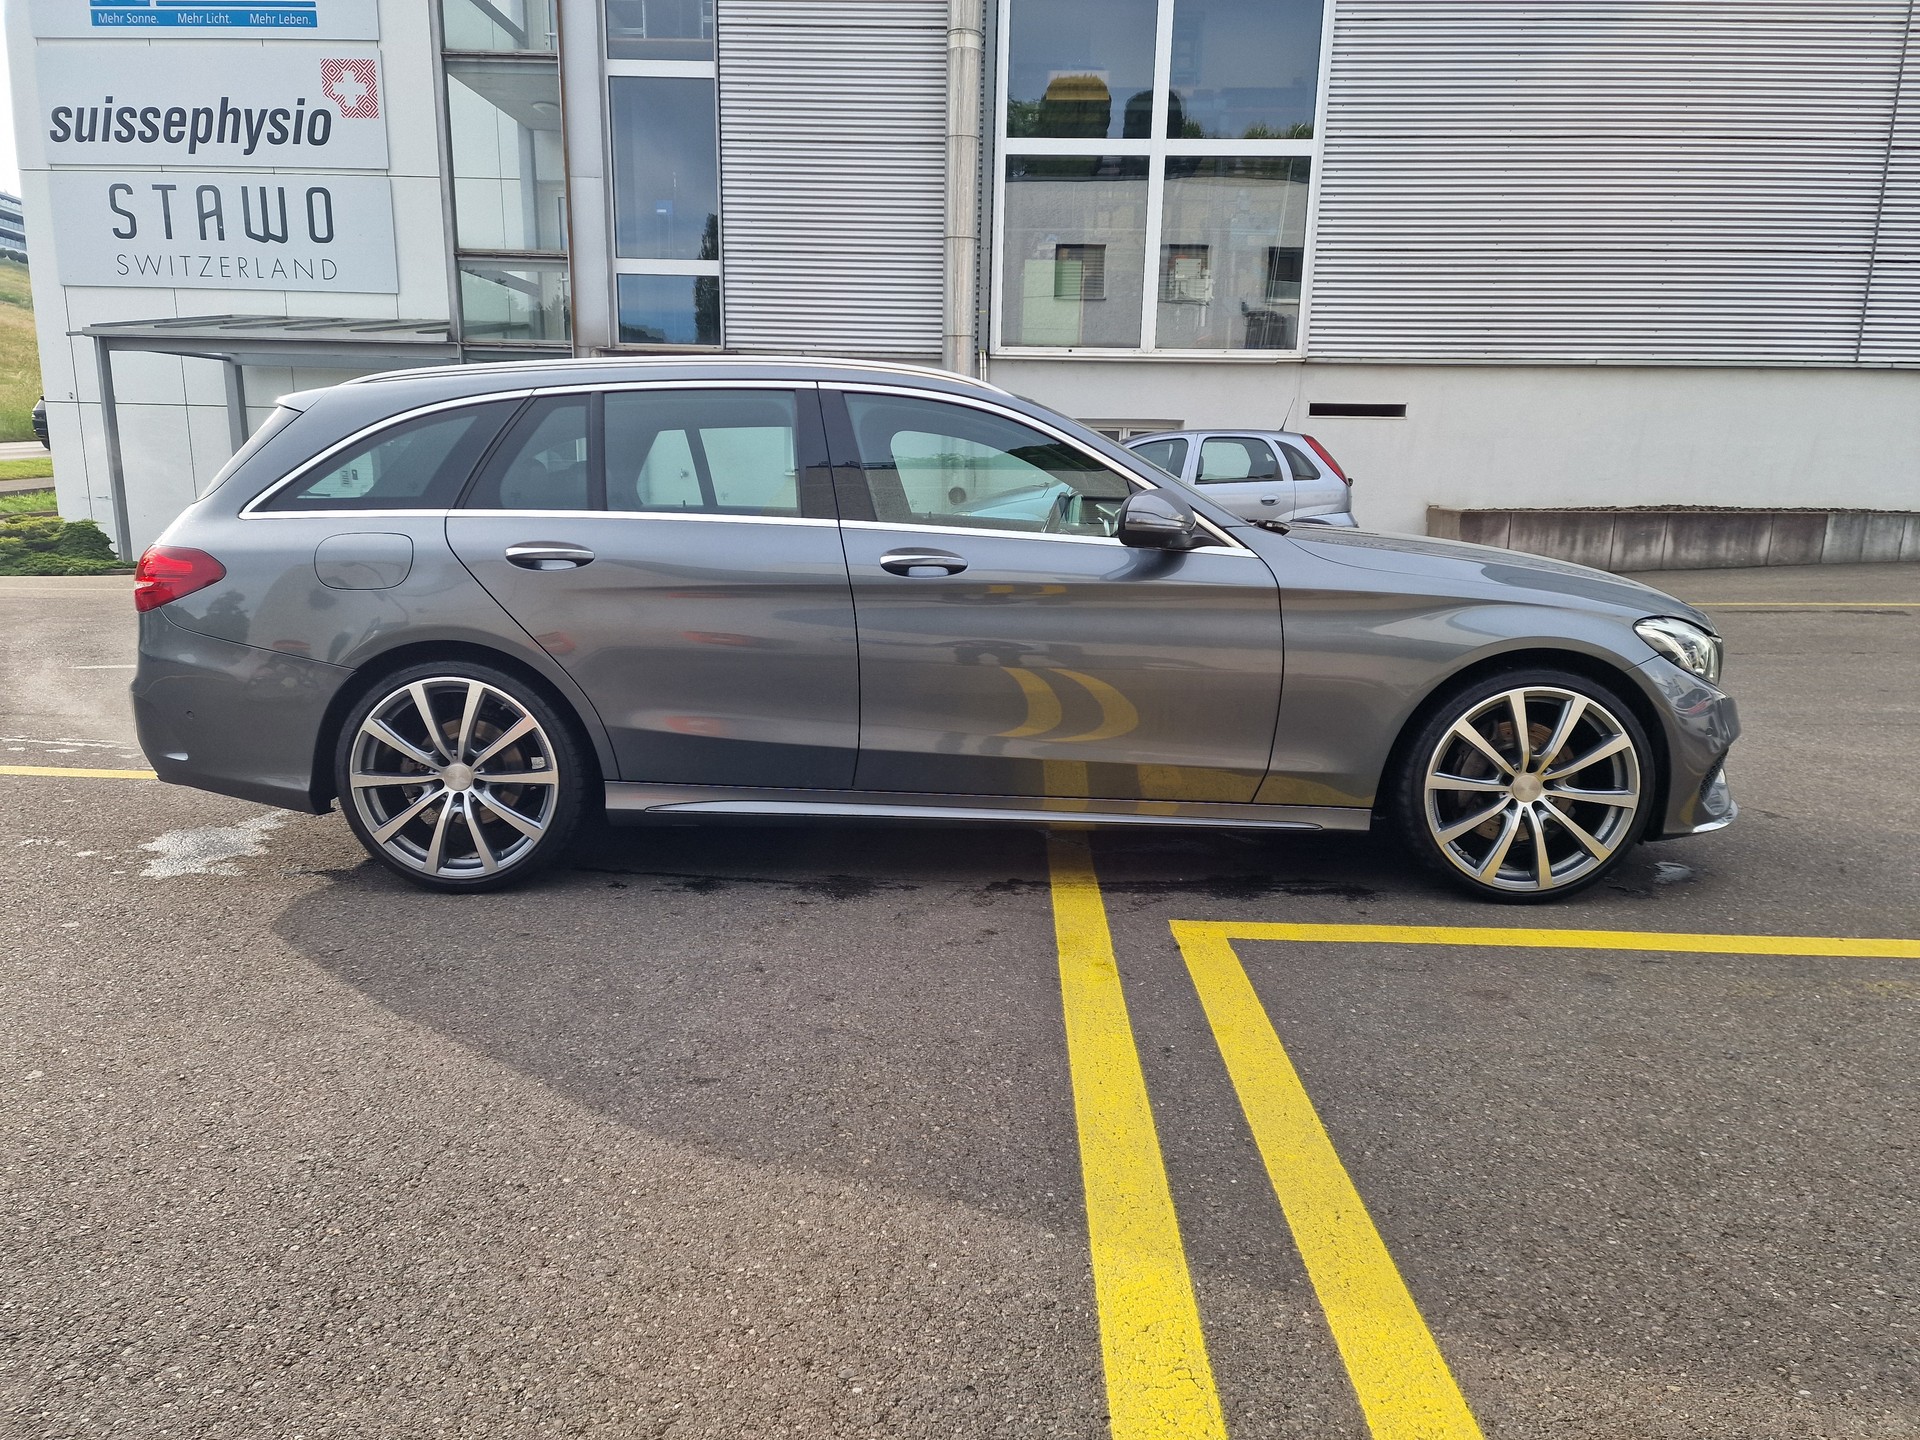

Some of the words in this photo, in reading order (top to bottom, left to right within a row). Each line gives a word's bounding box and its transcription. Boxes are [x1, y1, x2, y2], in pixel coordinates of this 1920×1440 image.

[98, 12, 124, 24] Mehr
[126, 12, 160, 24] Sonne.
[177, 12, 204, 24] Mehr
[206, 12, 233, 24] Licht.
[249, 13, 276, 25] Mehr
[278, 13, 312, 25] Leben.
[49, 95, 332, 155] suissephysio
[108, 183, 334, 244] STAWO
[116, 253, 338, 281] SWITZERLAND
